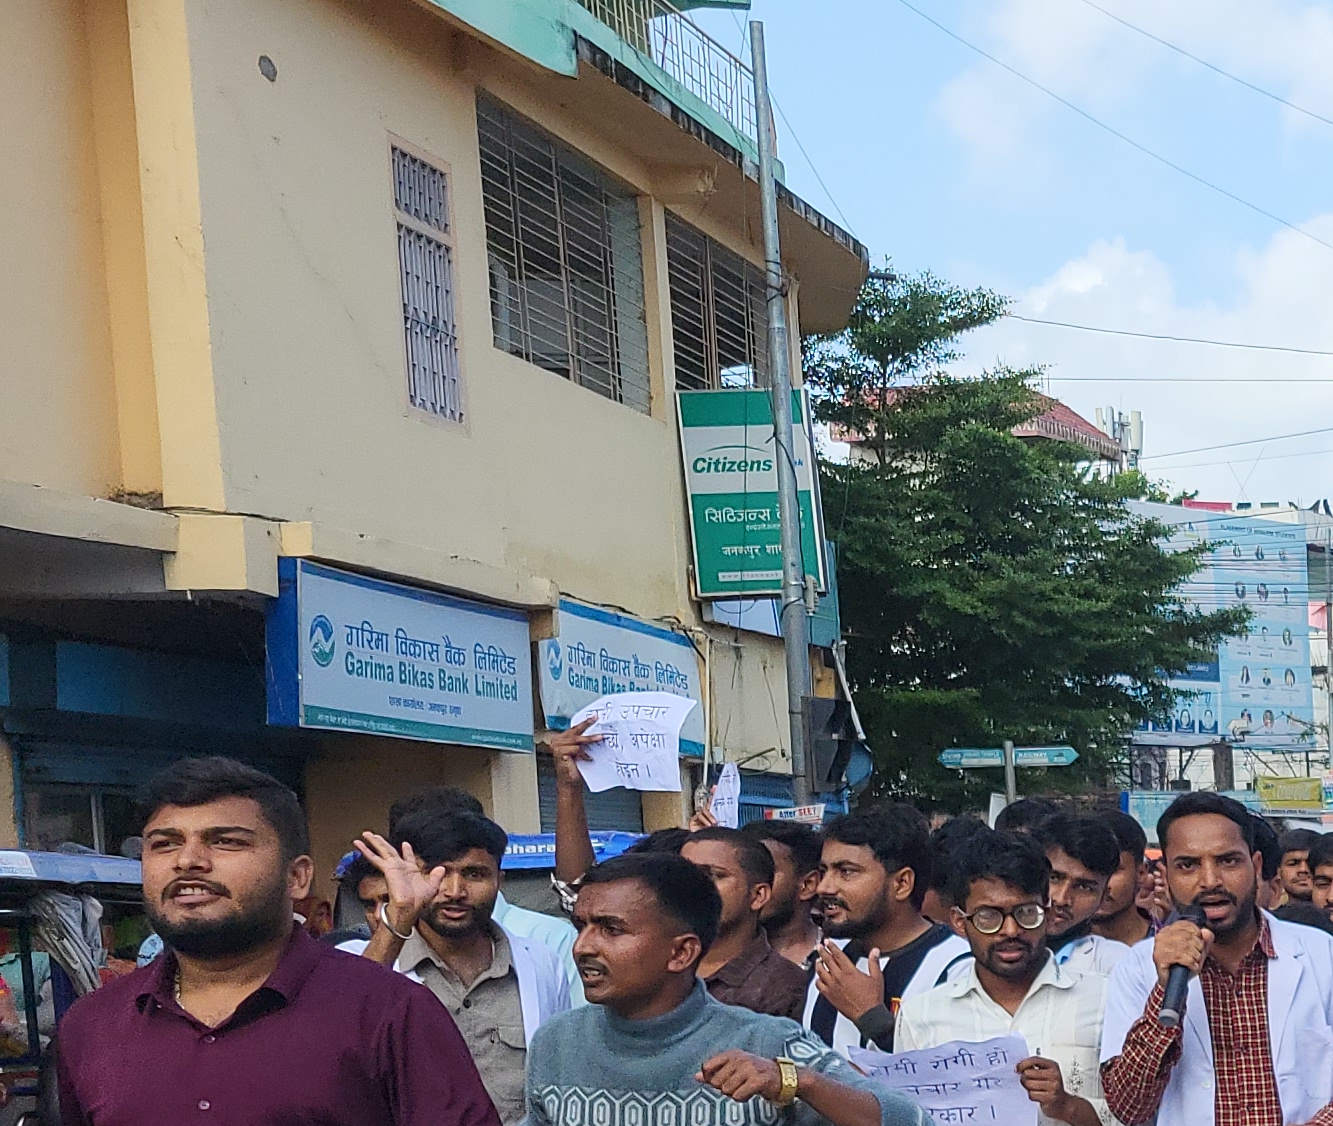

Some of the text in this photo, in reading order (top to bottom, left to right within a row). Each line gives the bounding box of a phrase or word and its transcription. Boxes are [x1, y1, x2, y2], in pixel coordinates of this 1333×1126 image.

[692, 457, 773, 474] Citizens
[344, 620, 517, 676] गरिमा विकास लिमिटेड
[344, 652, 518, 702] Garima Bikas Bank Limited
[568, 667, 599, 692] Garima
[600, 648, 631, 677] विकास
[655, 661, 688, 690] लिमिटेड
[929, 1048, 975, 1069] रोगी
[986, 1046, 1009, 1065] हो
